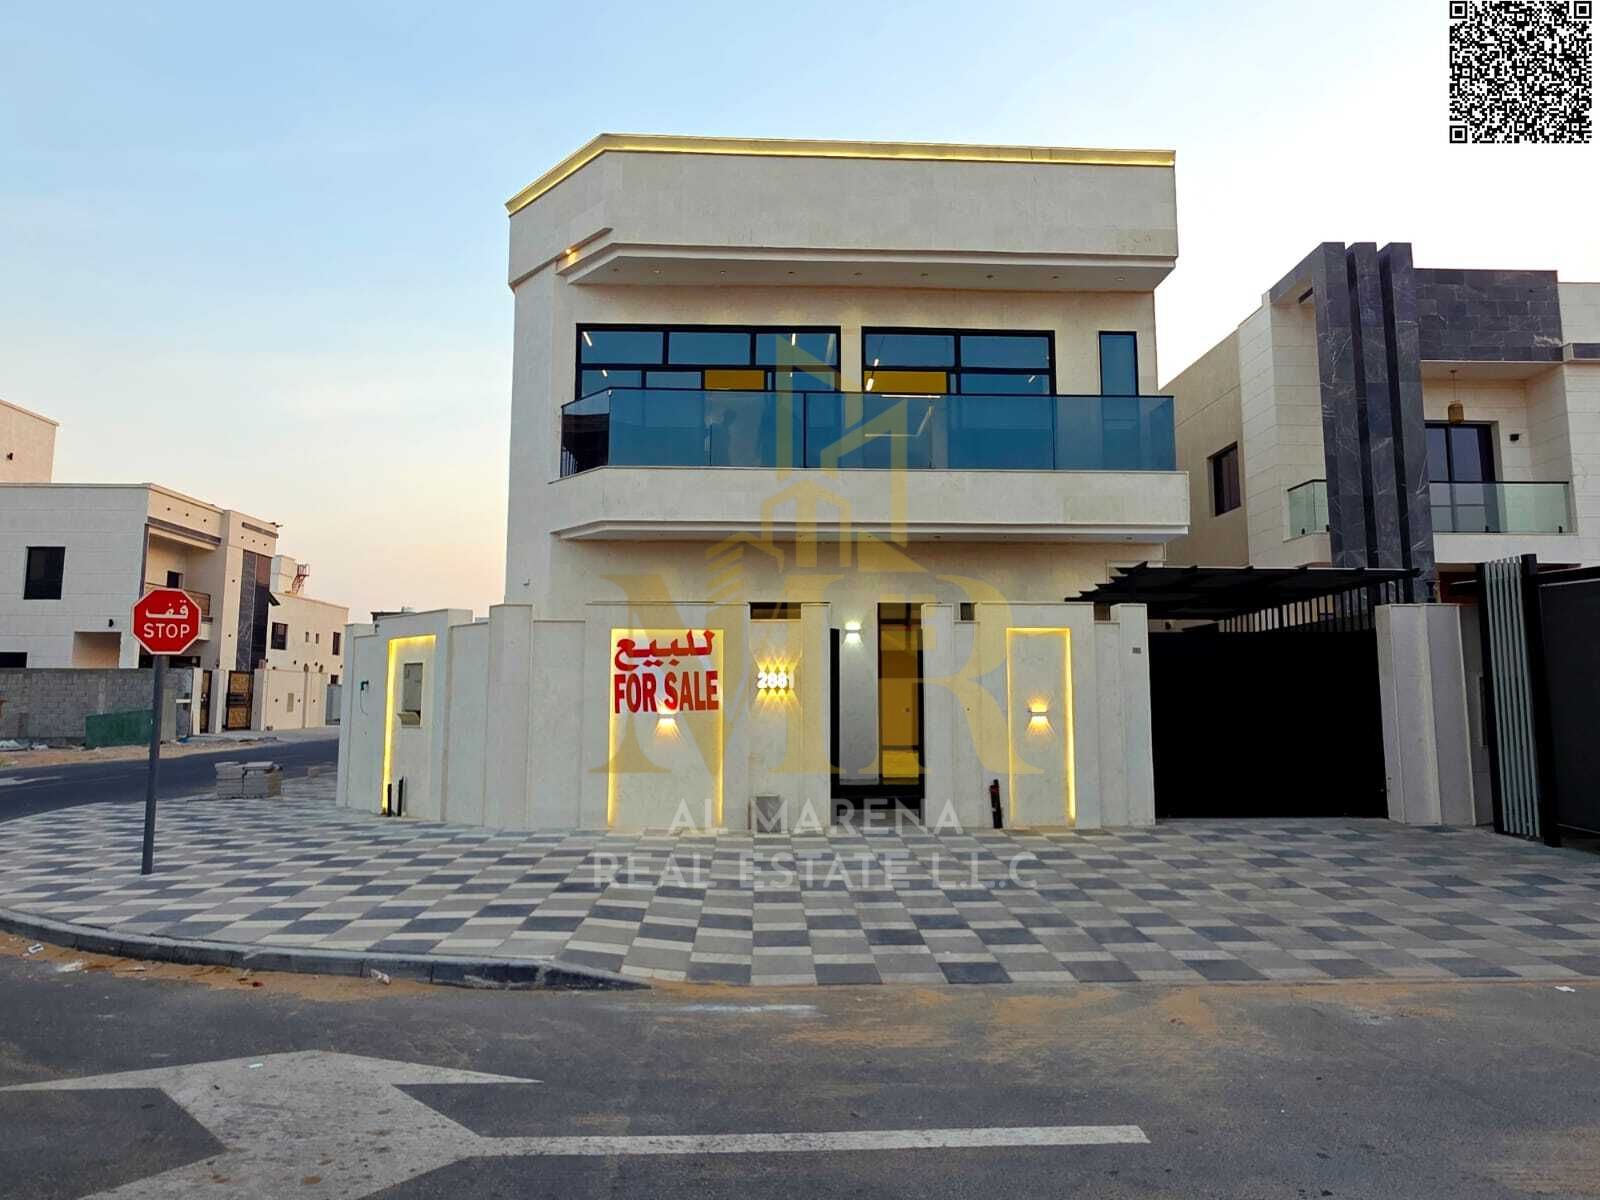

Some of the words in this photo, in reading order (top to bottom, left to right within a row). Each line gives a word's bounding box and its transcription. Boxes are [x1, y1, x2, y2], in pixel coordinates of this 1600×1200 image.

[145, 599, 189, 620] قف
[143, 623, 190, 639] STOP
[614, 628, 716, 672] للبيع
[614, 673, 658, 714] FOR
[664, 670, 719, 712] SALE
